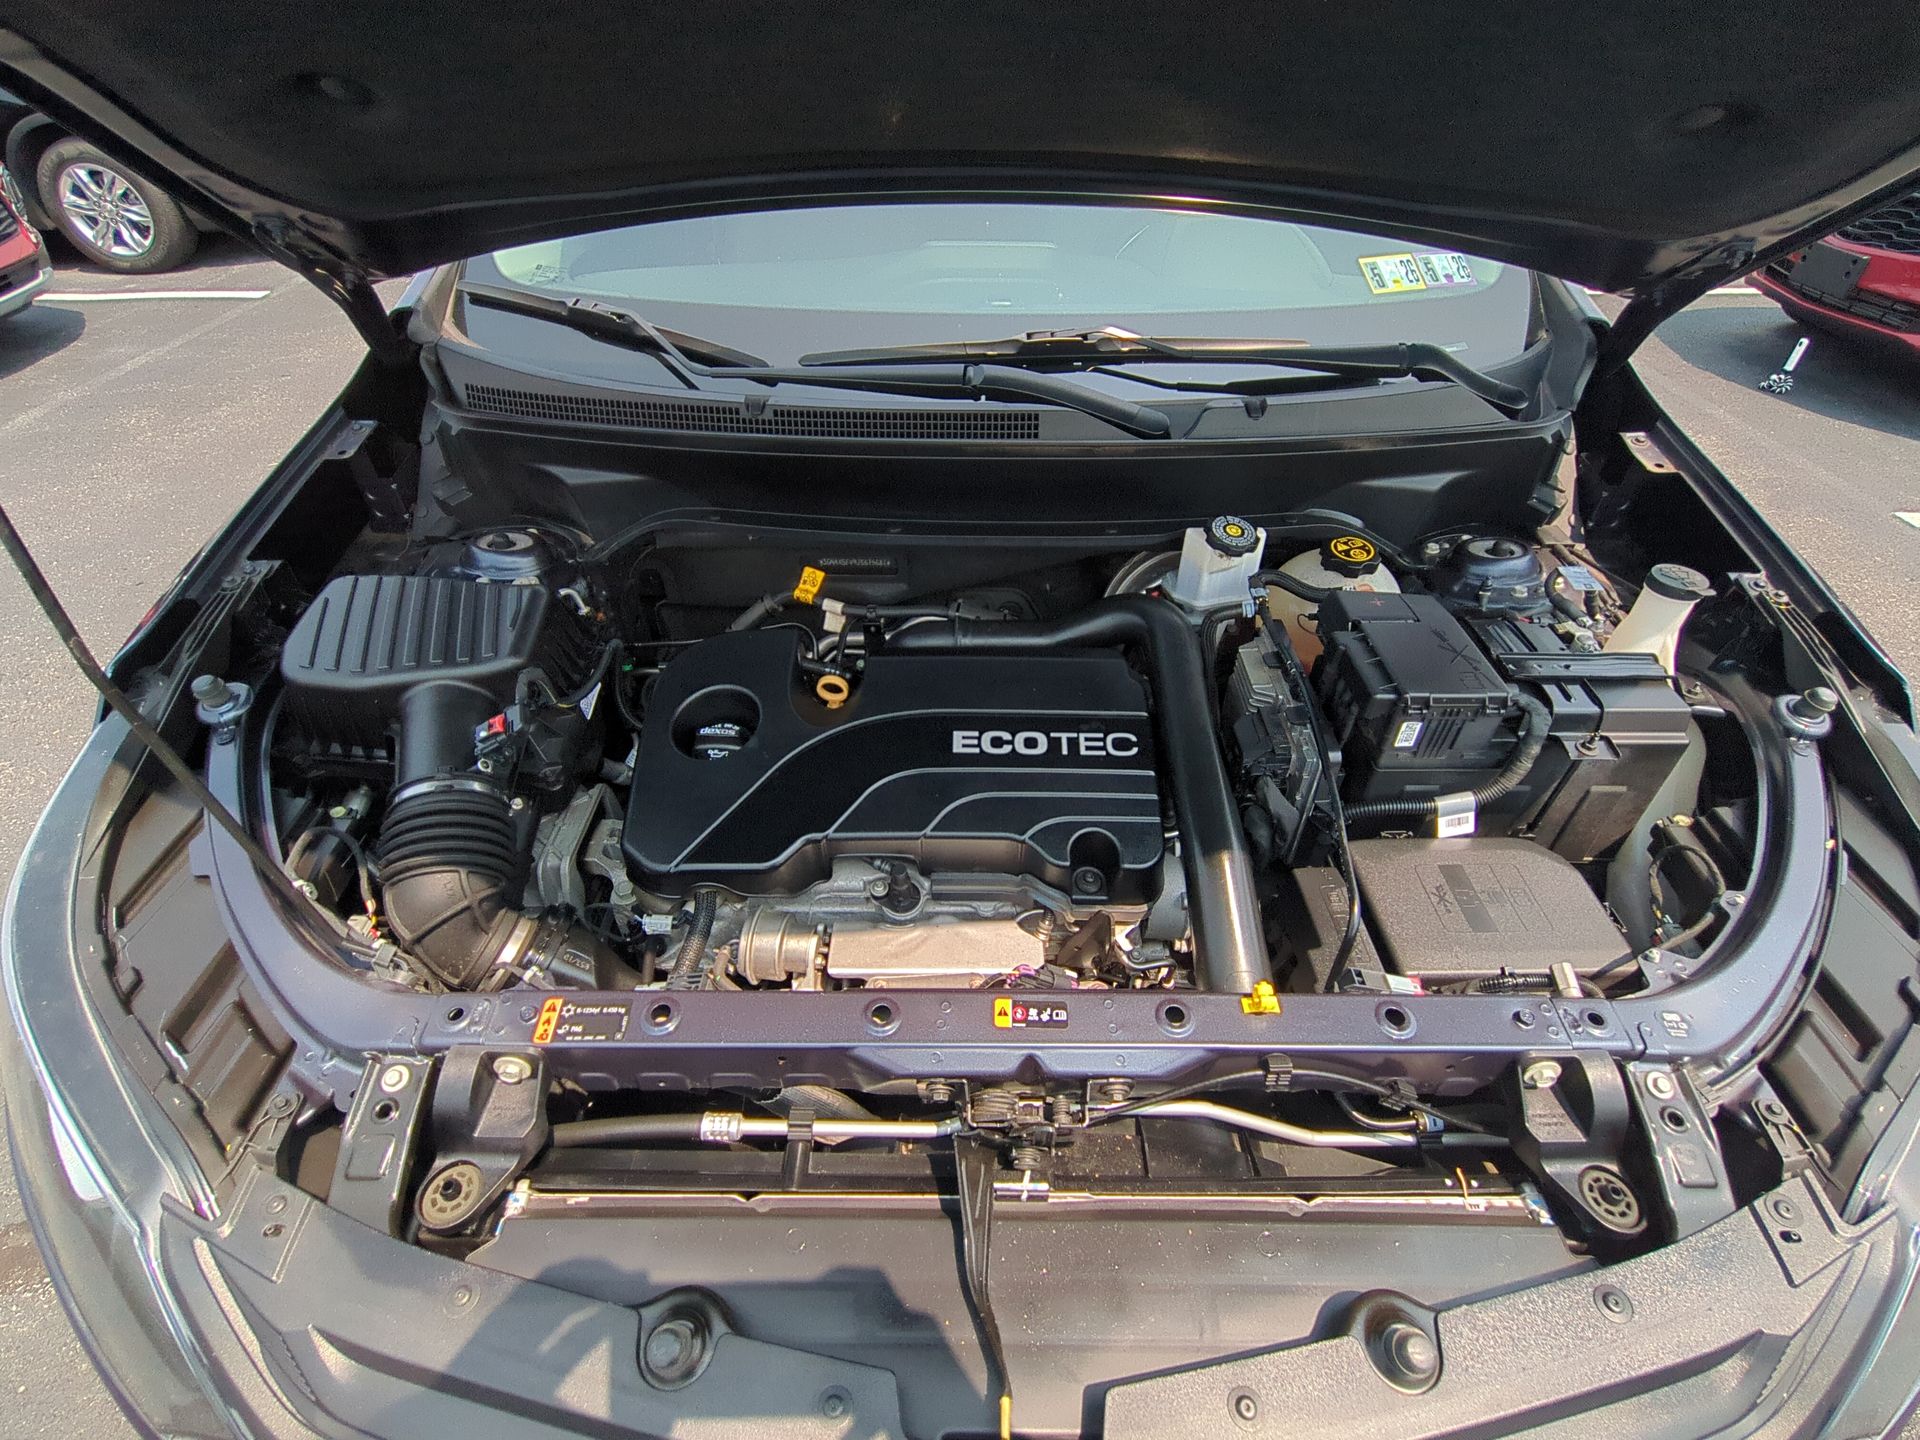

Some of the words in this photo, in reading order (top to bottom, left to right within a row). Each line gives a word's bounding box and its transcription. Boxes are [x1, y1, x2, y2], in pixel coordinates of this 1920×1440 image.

[1371, 266, 1386, 288] 5
[1399, 259, 1421, 284] 26
[1425, 261, 1440, 283] 5
[1451, 255, 1472, 280] 26
[699, 726, 737, 735] dexos
[952, 730, 1139, 757] ECOTEC
